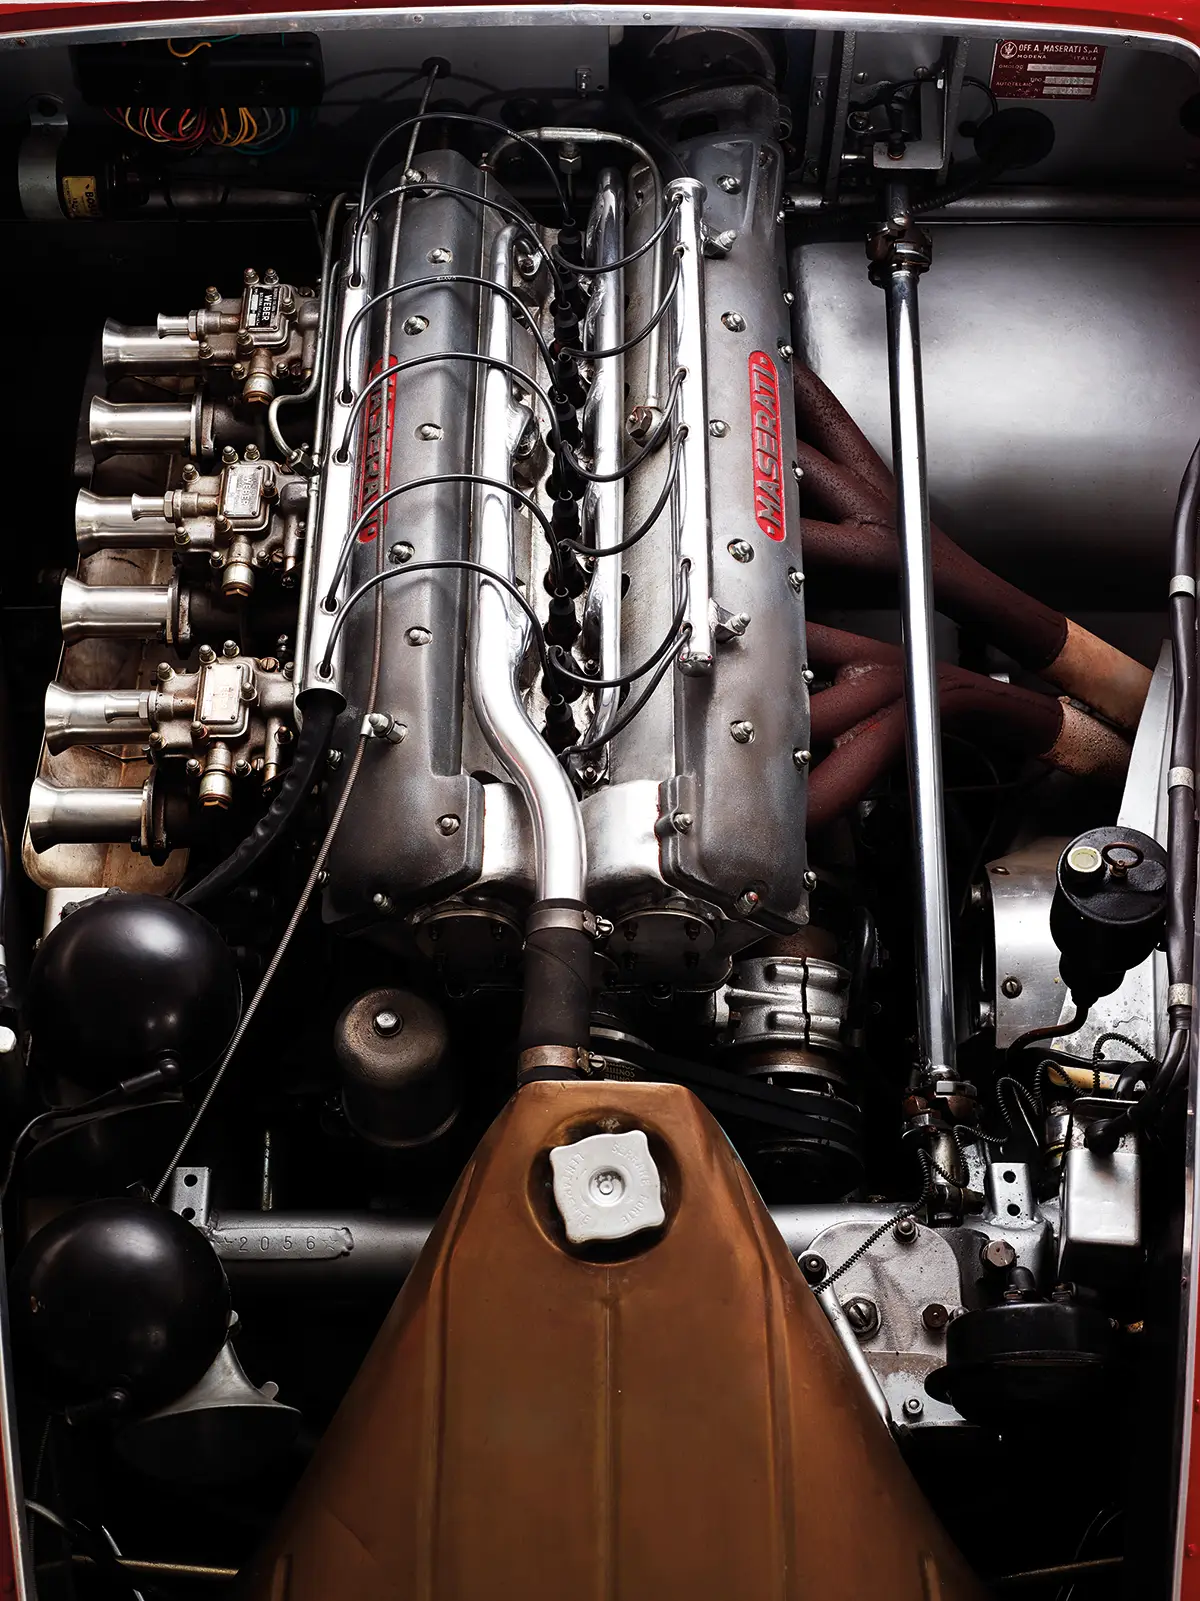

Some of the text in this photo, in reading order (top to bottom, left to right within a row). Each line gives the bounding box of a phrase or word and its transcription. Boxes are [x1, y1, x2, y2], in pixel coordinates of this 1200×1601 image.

[1043, 44, 1082, 53] MASERATI
[261, 294, 273, 321] WEBER
[752, 363, 781, 528] MASERATI
[241, 475, 252, 505] WEBER
[238, 1235, 316, 1252] 2056
